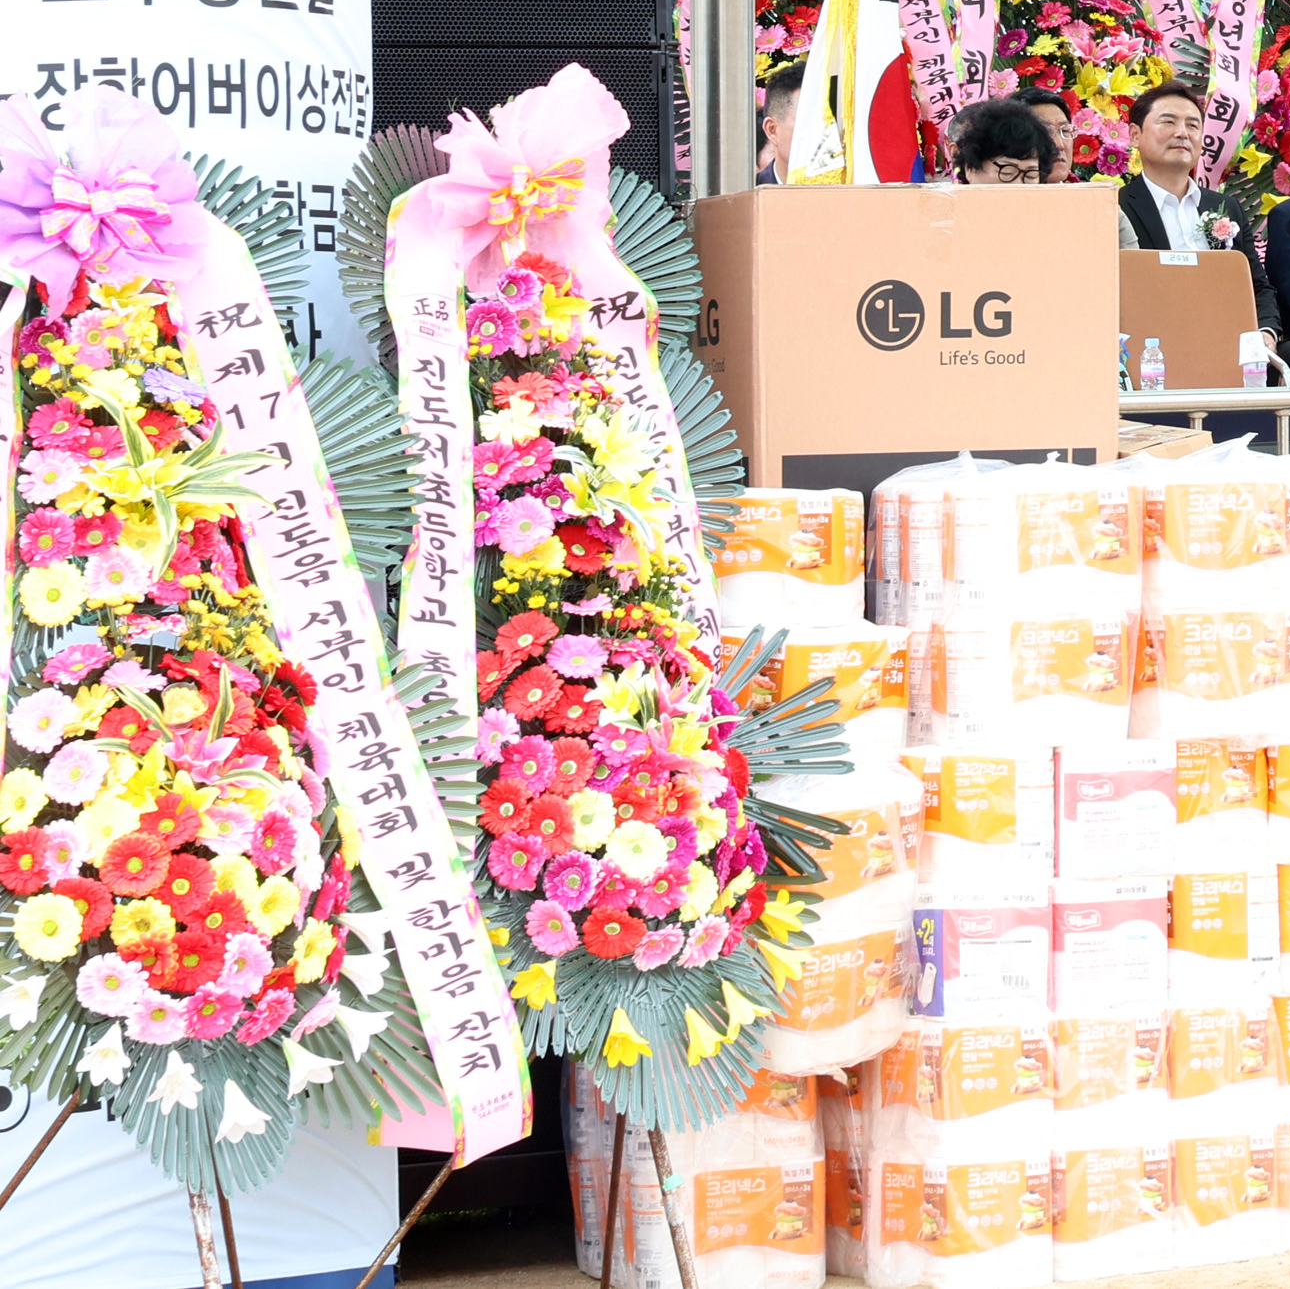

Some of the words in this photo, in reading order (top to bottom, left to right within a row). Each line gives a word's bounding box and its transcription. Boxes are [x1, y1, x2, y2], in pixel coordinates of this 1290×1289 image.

[195, 302, 262, 340] 祝
[939, 290, 1014, 340] LG
[938, 349, 980, 368] Life's
[984, 349, 1027, 368] Good
[408, 354, 459, 629] 진도서초등학교
[257, 488, 339, 590] 진도읍
[297, 599, 368, 694] 서부인
[334, 711, 420, 840] 체육대회
[385, 850, 437, 893] 및
[404, 899, 484, 1001] 한마음
[446, 1009, 503, 1079] 잔치
